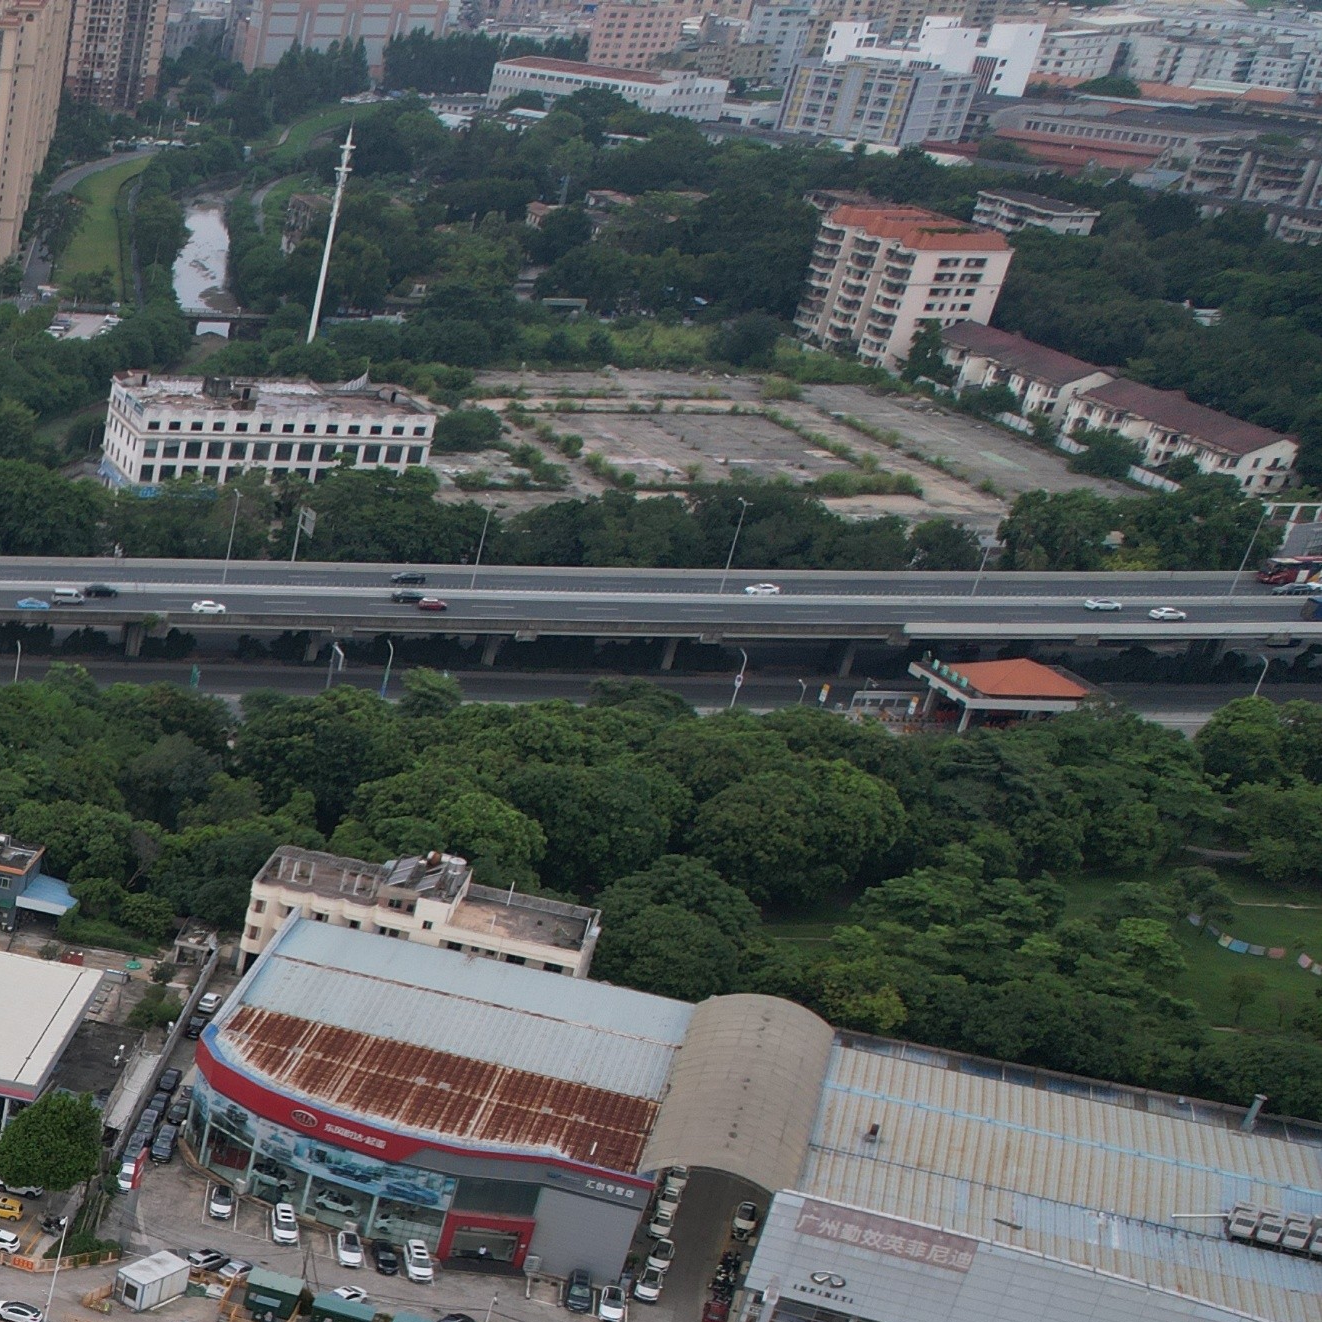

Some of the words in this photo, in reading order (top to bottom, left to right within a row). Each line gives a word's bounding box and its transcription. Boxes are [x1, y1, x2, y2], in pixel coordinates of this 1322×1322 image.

[796, 1213, 973, 1269] 广州勤效英菲尼迪
[793, 1283, 854, 1304] INFINITI
